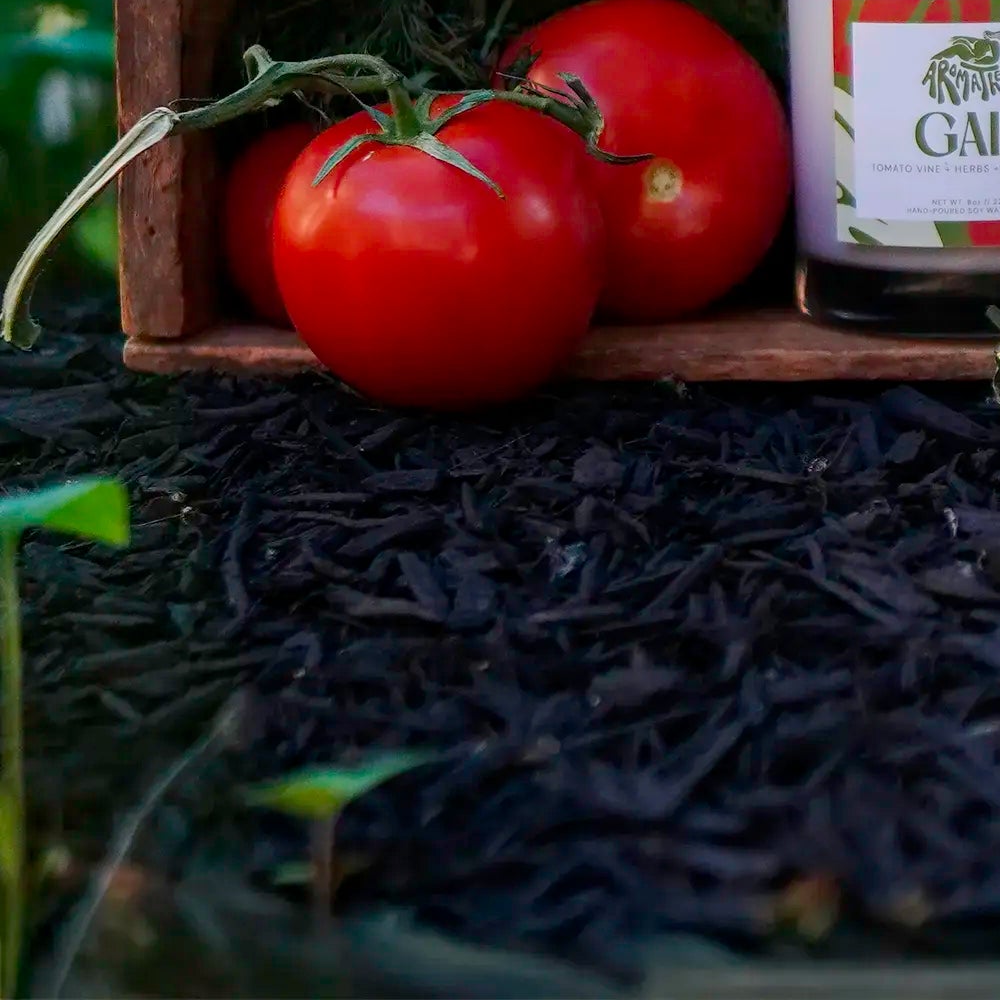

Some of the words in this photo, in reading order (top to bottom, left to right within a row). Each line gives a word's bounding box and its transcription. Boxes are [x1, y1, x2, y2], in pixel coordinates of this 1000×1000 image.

[873, 163, 913, 173] TOMATO
[916, 163, 941, 173] VINE
[954, 163, 990, 173] HERBS
